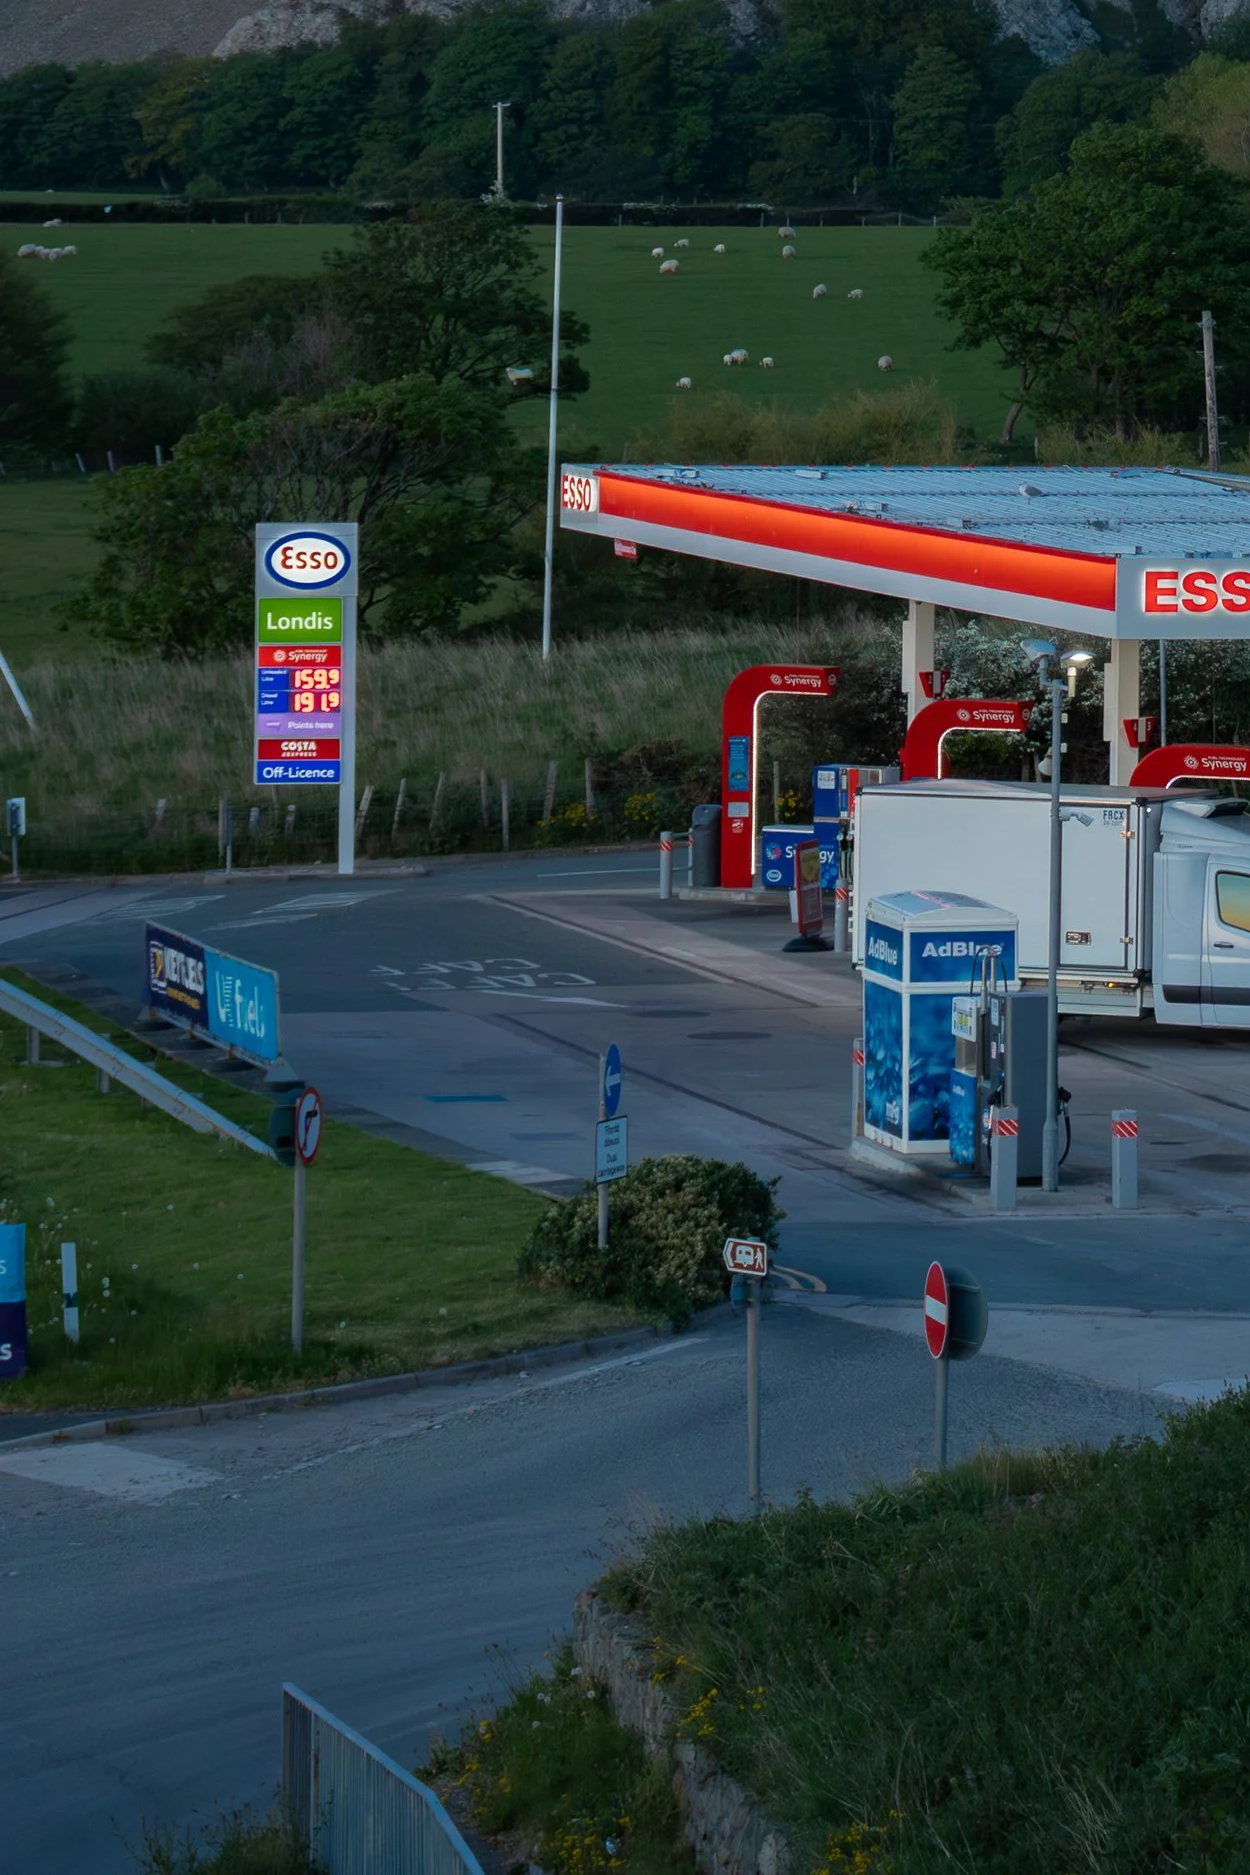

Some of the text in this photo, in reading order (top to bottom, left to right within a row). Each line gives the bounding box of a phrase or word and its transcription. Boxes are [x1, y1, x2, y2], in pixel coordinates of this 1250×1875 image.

[561, 475, 591, 511] ESSO
[280, 546, 338, 570] Esso
[266, 611, 333, 630] Londis
[288, 651, 328, 663] Synergy
[784, 675, 822, 688] Synergy
[972, 710, 1015, 724] Synergy
[288, 721, 314, 729] Points
[280, 741, 318, 751] COSTA
[1201, 757, 1248, 772] Synergy
[262, 766, 336, 779] Off-Licence
[868, 936, 898, 966] AdBlue
[921, 941, 1003, 958] AdBlue
